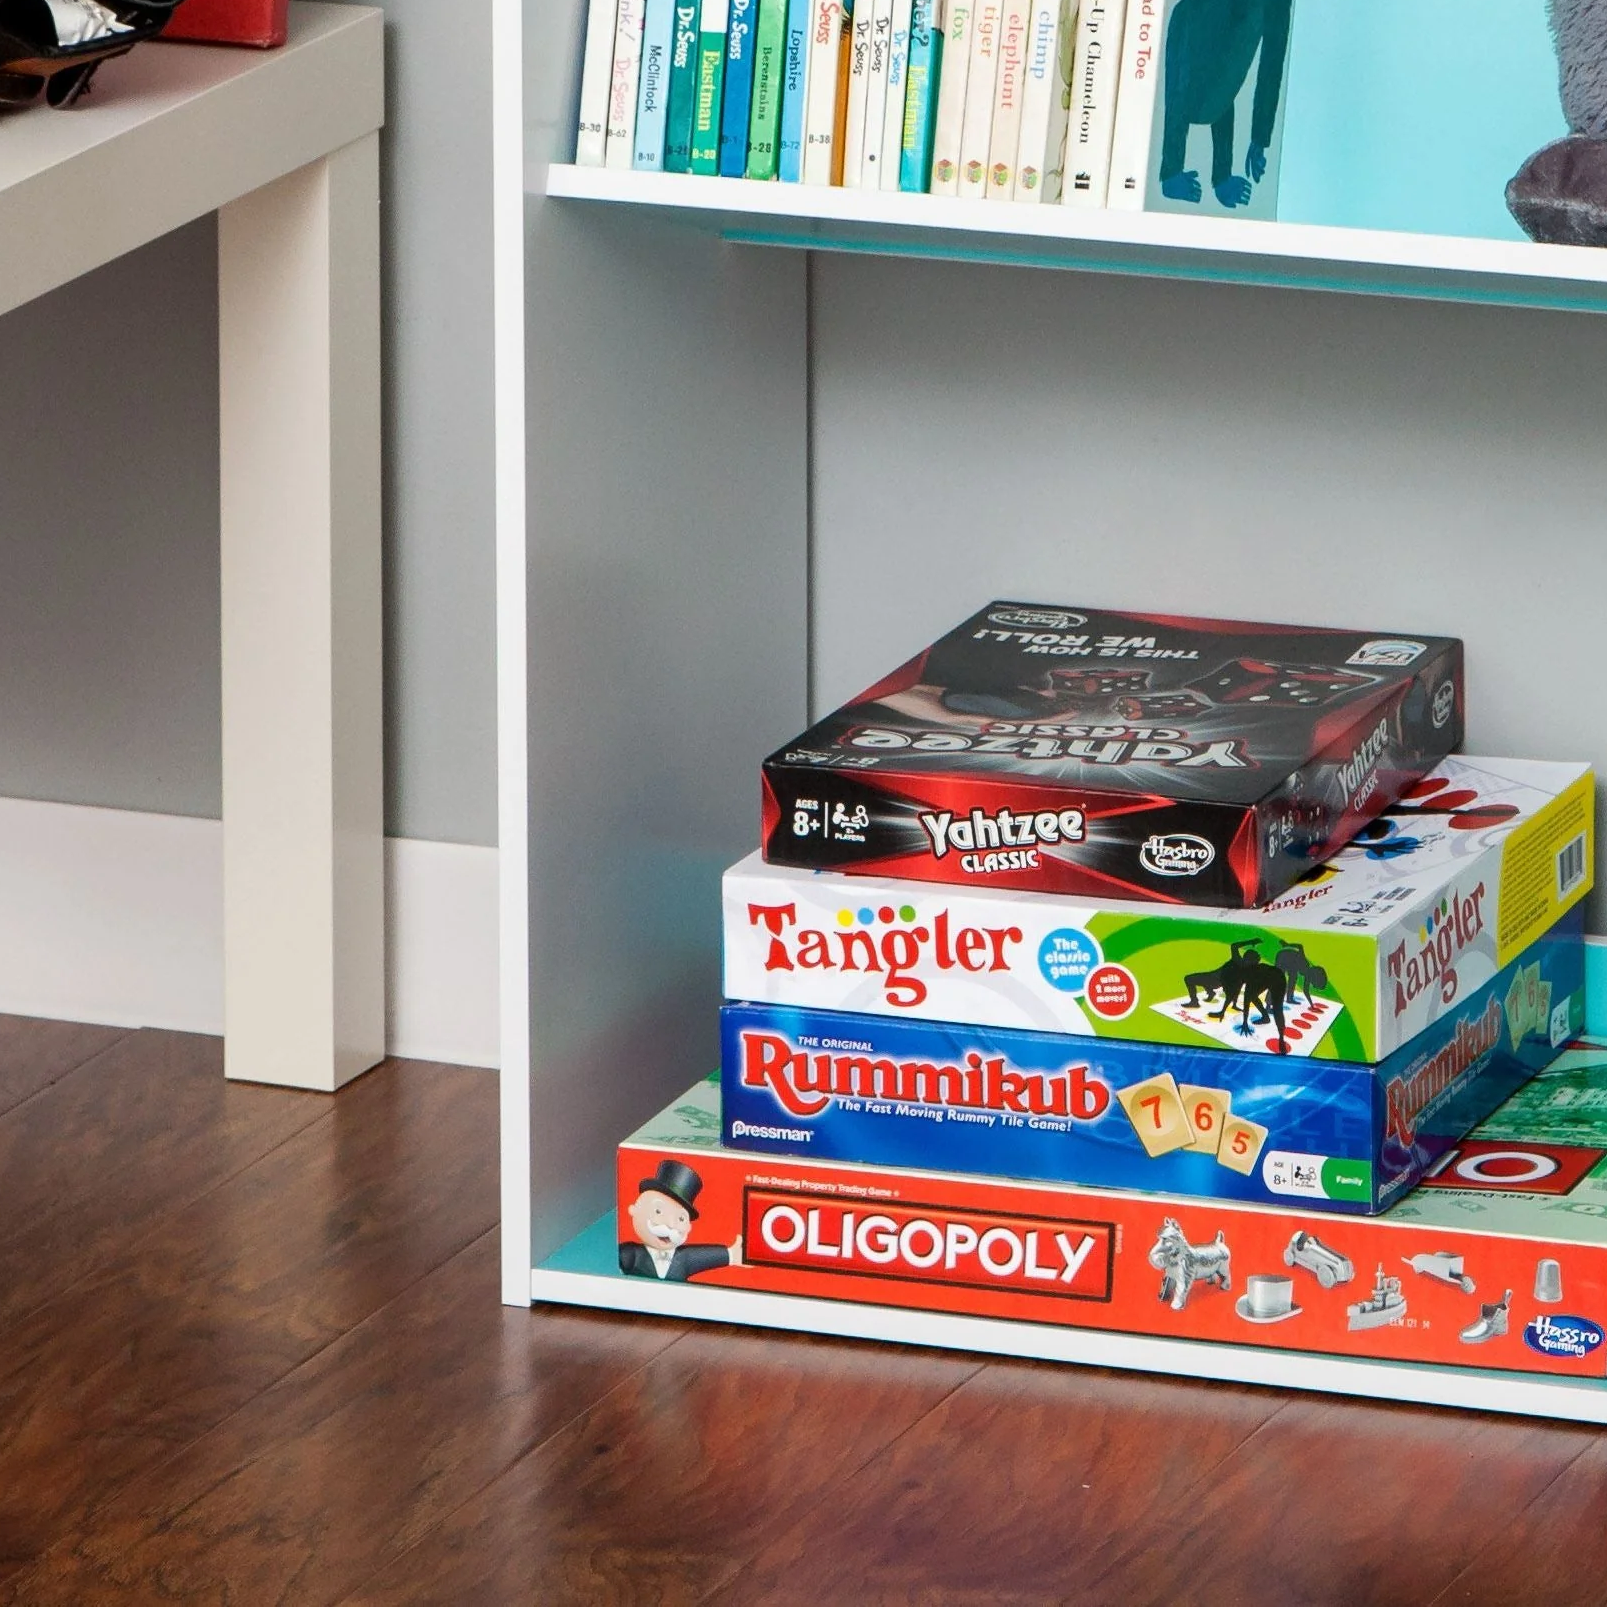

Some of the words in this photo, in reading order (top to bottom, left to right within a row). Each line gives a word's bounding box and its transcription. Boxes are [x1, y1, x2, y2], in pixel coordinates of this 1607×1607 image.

[729, 18, 749, 60] Seuss
[816, 0, 839, 45] Seuss
[952, 6, 970, 41] fox
[978, 6, 999, 57] tiger
[1138, 23, 1153, 42] to
[674, 29, 695, 69] Seuss
[787, 29, 804, 91] Lopshire
[853, 42, 869, 76] Seuss
[872, 38, 888, 73] Seuss
[1000, 13, 1024, 110] elephant
[1029, 10, 1055, 80] chimp
[1134, 44, 1152, 80] Toe
[644, 44, 662, 113] McClintock
[757, 46, 773, 120] Berenstains
[889, 53, 907, 85] Seuss
[697, 49, 721, 132] Eastman
[1079, 41, 1102, 143] Chameleon
[972, 628, 1091, 647] ROLL!
[1022, 645, 1091, 656] HOW
[1096, 634, 1156, 647] WE
[1097, 647, 1135, 658] IS
[1142, 649, 1200, 660] THIS
[848, 729, 1249, 768] Yahtzee
[988, 724, 1181, 741] CLASSIC
[1336, 717, 1389, 807] Yahtzee
[795, 799, 819, 810] AGES
[793, 810, 821, 836] 8+
[920, 807, 1084, 857] Yahtzee
[960, 849, 1040, 874] CLASSIC
[1145, 837, 1208, 860] Hasbro
[1262, 885, 1333, 914] Tangler
[747, 901, 1023, 1007] Tangler
[1044, 950, 1091, 964] classic
[1052, 937, 1079, 950] The
[1387, 881, 1485, 1019] Tangler
[1050, 965, 1089, 980] game
[797, 1036, 819, 1048] THE
[822, 1037, 874, 1052] ORIGINAL
[742, 1032, 1110, 1119] Rummikub
[1386, 992, 1502, 1149] Rummikub
[838, 1099, 860, 1112] The
[865, 1101, 892, 1115] Fast
[895, 1104, 943, 1123] Moving
[947, 1110, 996, 1128] Rummy
[1001, 1114, 1024, 1129] Tile
[1028, 1118, 1072, 1133] Game!
[1140, 1095, 1162, 1129] 7
[1194, 1102, 1213, 1131] 6
[1231, 1131, 1251, 1155] 5
[752, 1175, 800, 1190] Fast-Dealing
[801, 1179, 837, 1192] Property
[838, 1183, 867, 1196] Trading
[868, 1187, 892, 1197] Game
[1336, 1175, 1363, 1186] Family
[760, 1205, 1096, 1284] OLIGOPOLY
[1539, 1334, 1586, 1358] Gaming
